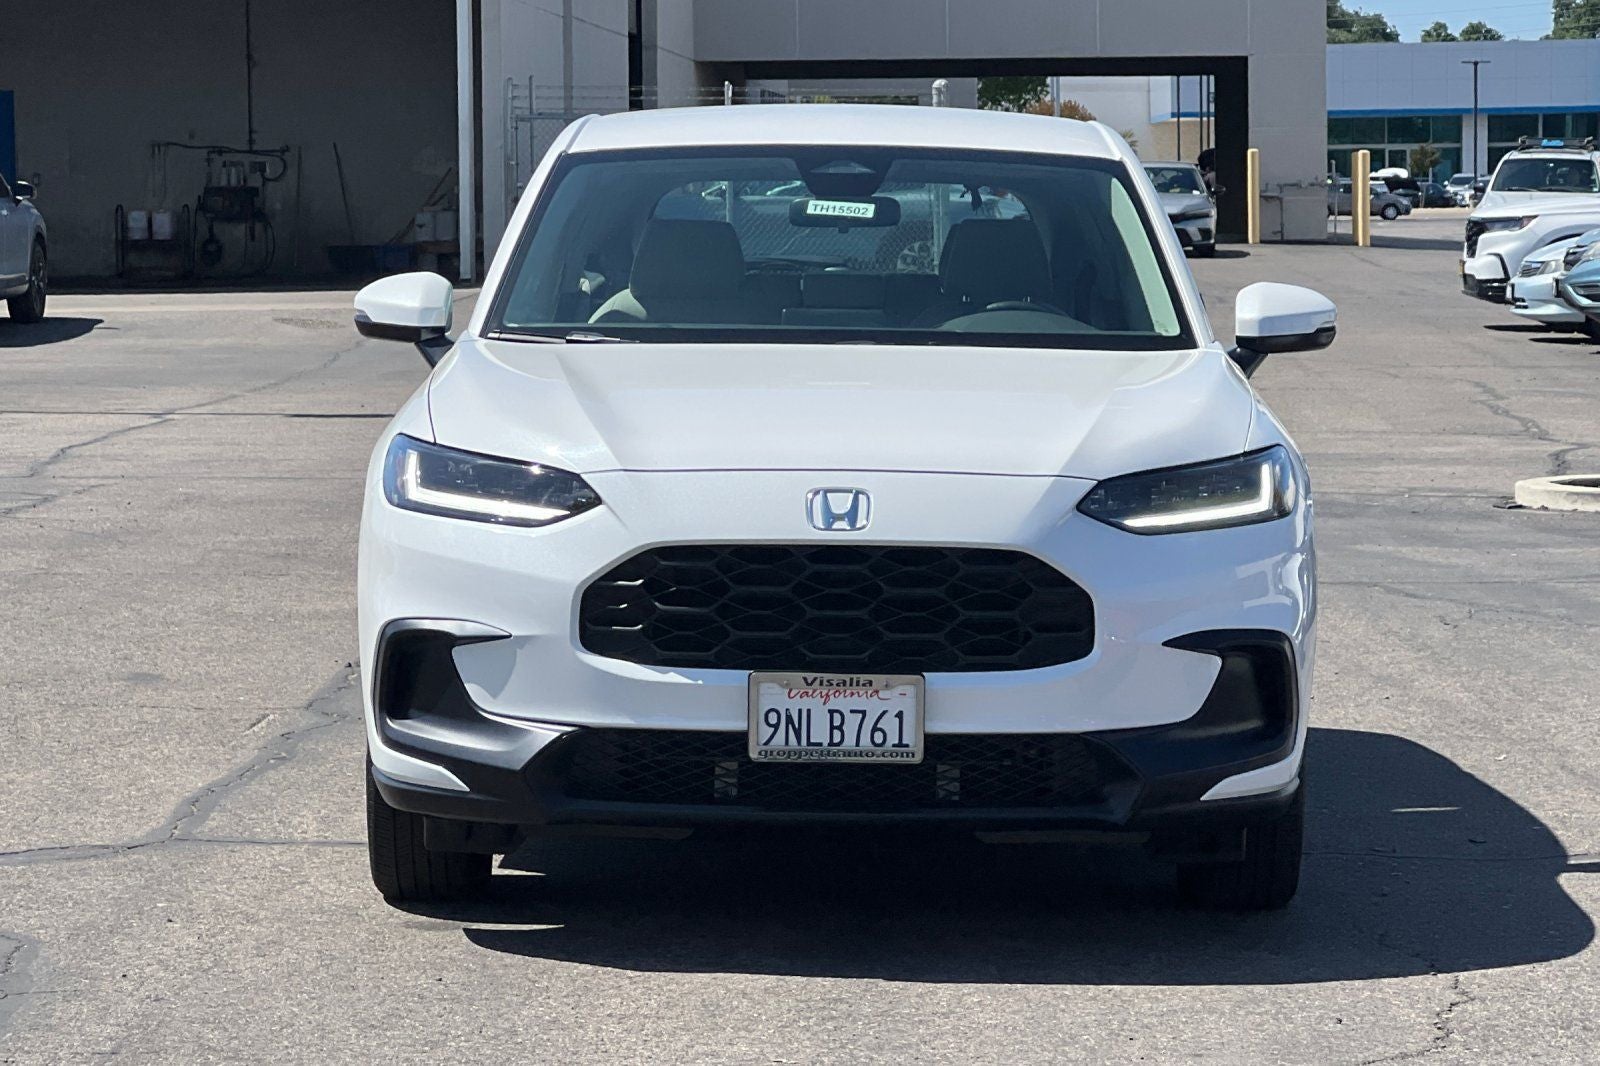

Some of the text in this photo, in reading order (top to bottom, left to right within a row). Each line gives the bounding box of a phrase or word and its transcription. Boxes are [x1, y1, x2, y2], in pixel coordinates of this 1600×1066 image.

[812, 203, 868, 216] TH15502
[801, 676, 874, 688] Visalia
[762, 707, 910, 748] 9NLB761
[757, 749, 916, 760] groppettiauto.com
